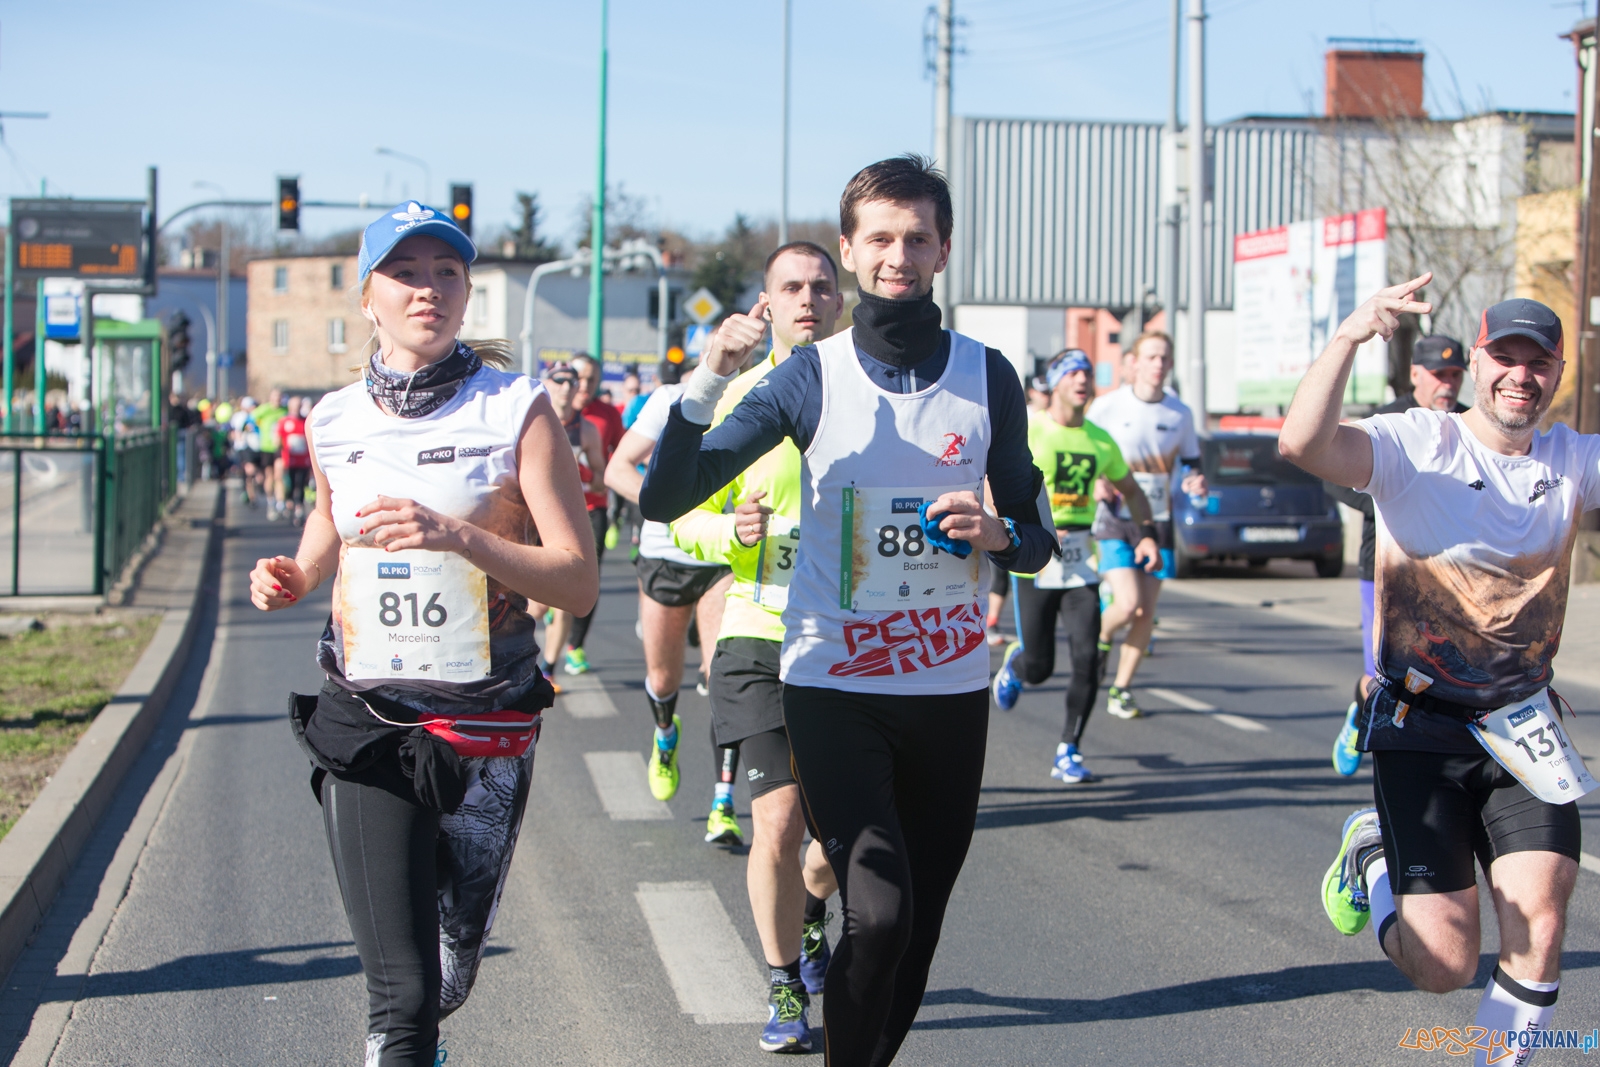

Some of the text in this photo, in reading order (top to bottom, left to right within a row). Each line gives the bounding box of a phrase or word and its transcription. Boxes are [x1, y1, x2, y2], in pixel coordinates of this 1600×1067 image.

[432, 449, 453, 459] PKO
[894, 502, 905, 510] 10.
[905, 501, 921, 510] PKO
[776, 544, 799, 571] 3
[380, 566, 391, 575] 10.
[391, 566, 409, 575] PKO
[903, 561, 940, 571] Bartosz
[378, 591, 448, 628] 816
[388, 632, 441, 643] Marcelina
